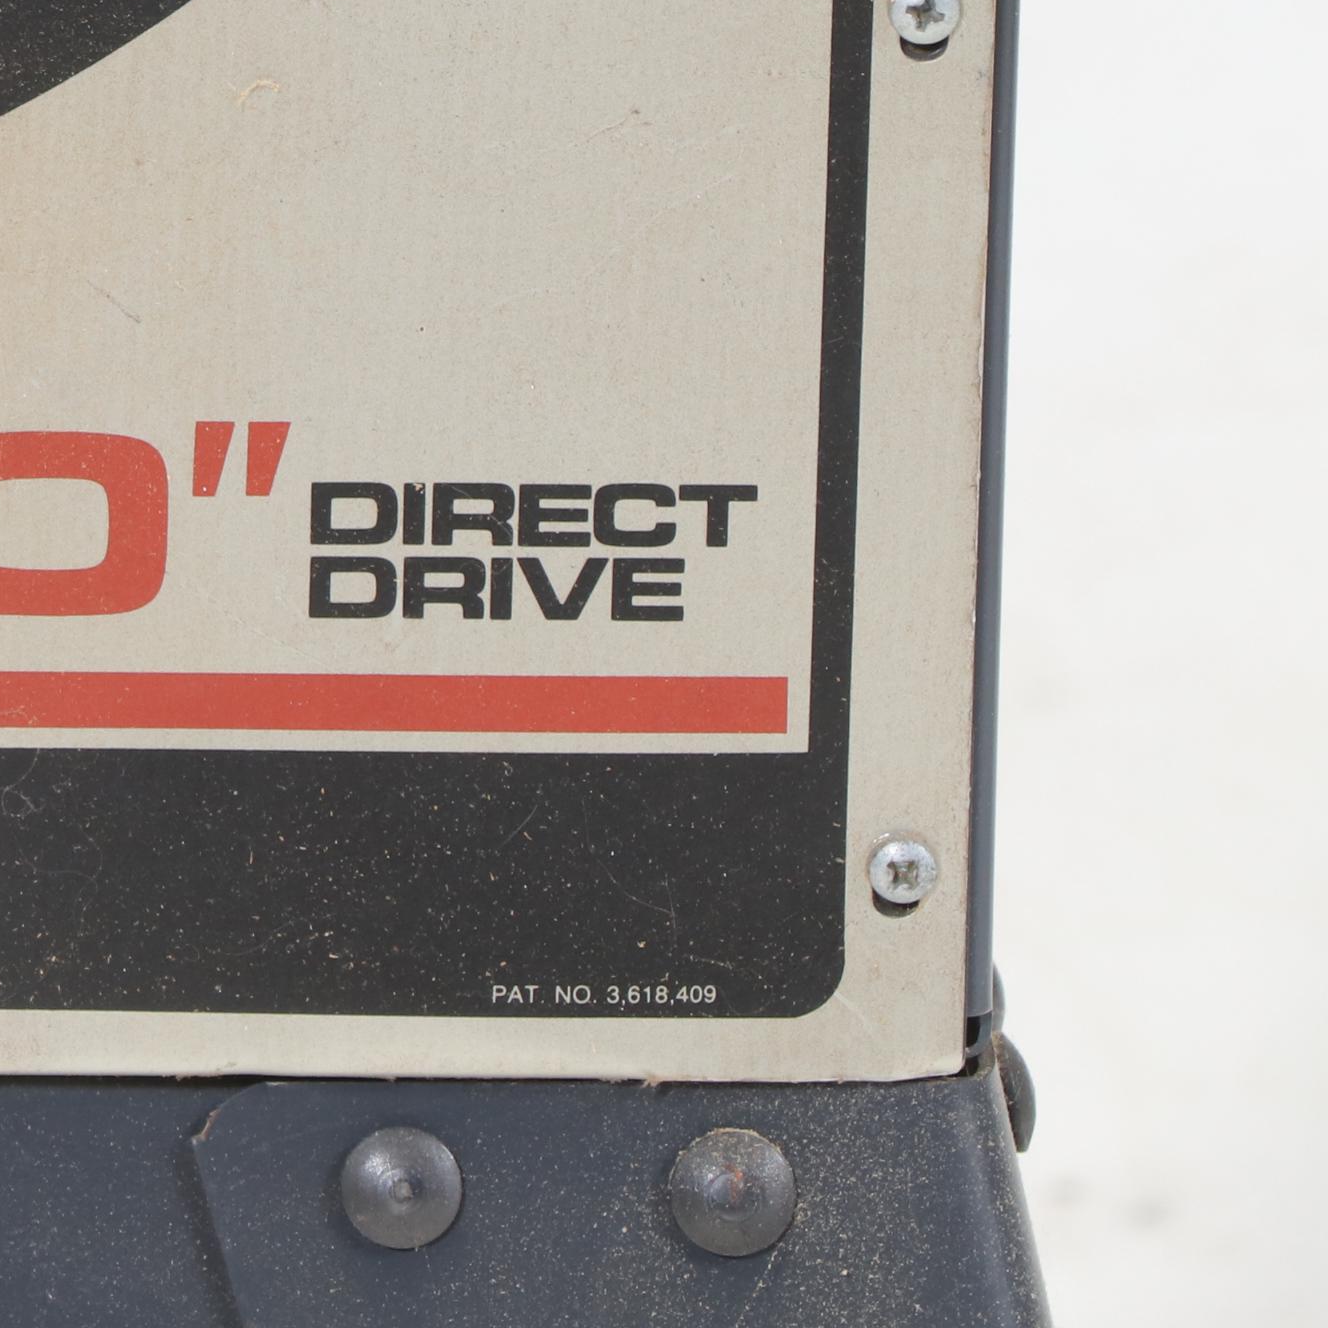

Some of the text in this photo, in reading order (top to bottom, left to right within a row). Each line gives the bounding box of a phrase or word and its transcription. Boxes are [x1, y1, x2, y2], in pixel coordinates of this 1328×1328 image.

[308, 481, 758, 551] DIRECT
[307, 556, 685, 622] DRIVE
[492, 984, 717, 1006] PAT. NO. 3,618,409
